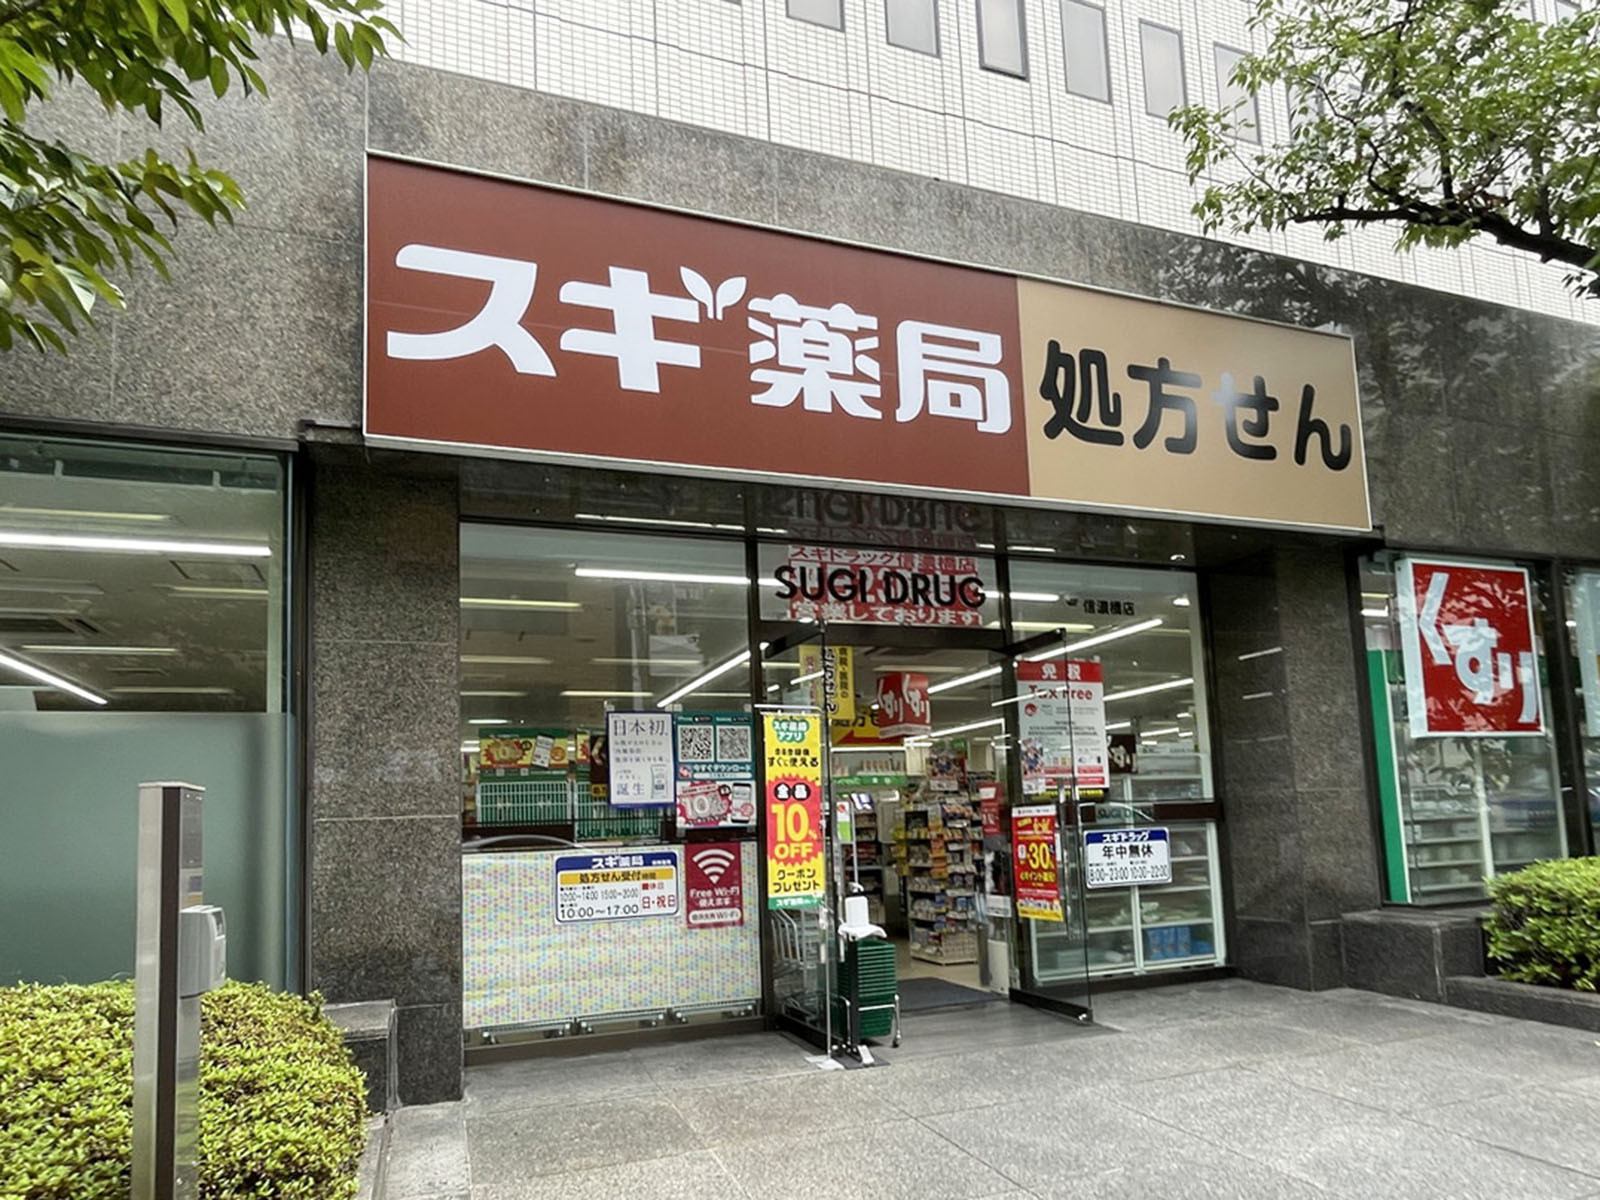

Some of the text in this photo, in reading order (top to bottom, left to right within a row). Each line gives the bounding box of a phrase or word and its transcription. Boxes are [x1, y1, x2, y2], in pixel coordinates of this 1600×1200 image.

[386, 243, 1012, 434] スギ薬局
[1040, 339, 1351, 471] 処方せん
[775, 565, 868, 603] SUGI
[882, 571, 986, 608] DRUG
[1418, 571, 1538, 723] くすり
[774, 843, 813, 859] OFF
[1102, 843, 1154, 859] 年中無休
[777, 868, 816, 880] クーポン
[690, 888, 712, 899] Free
[773, 880, 821, 893] プレゼント
